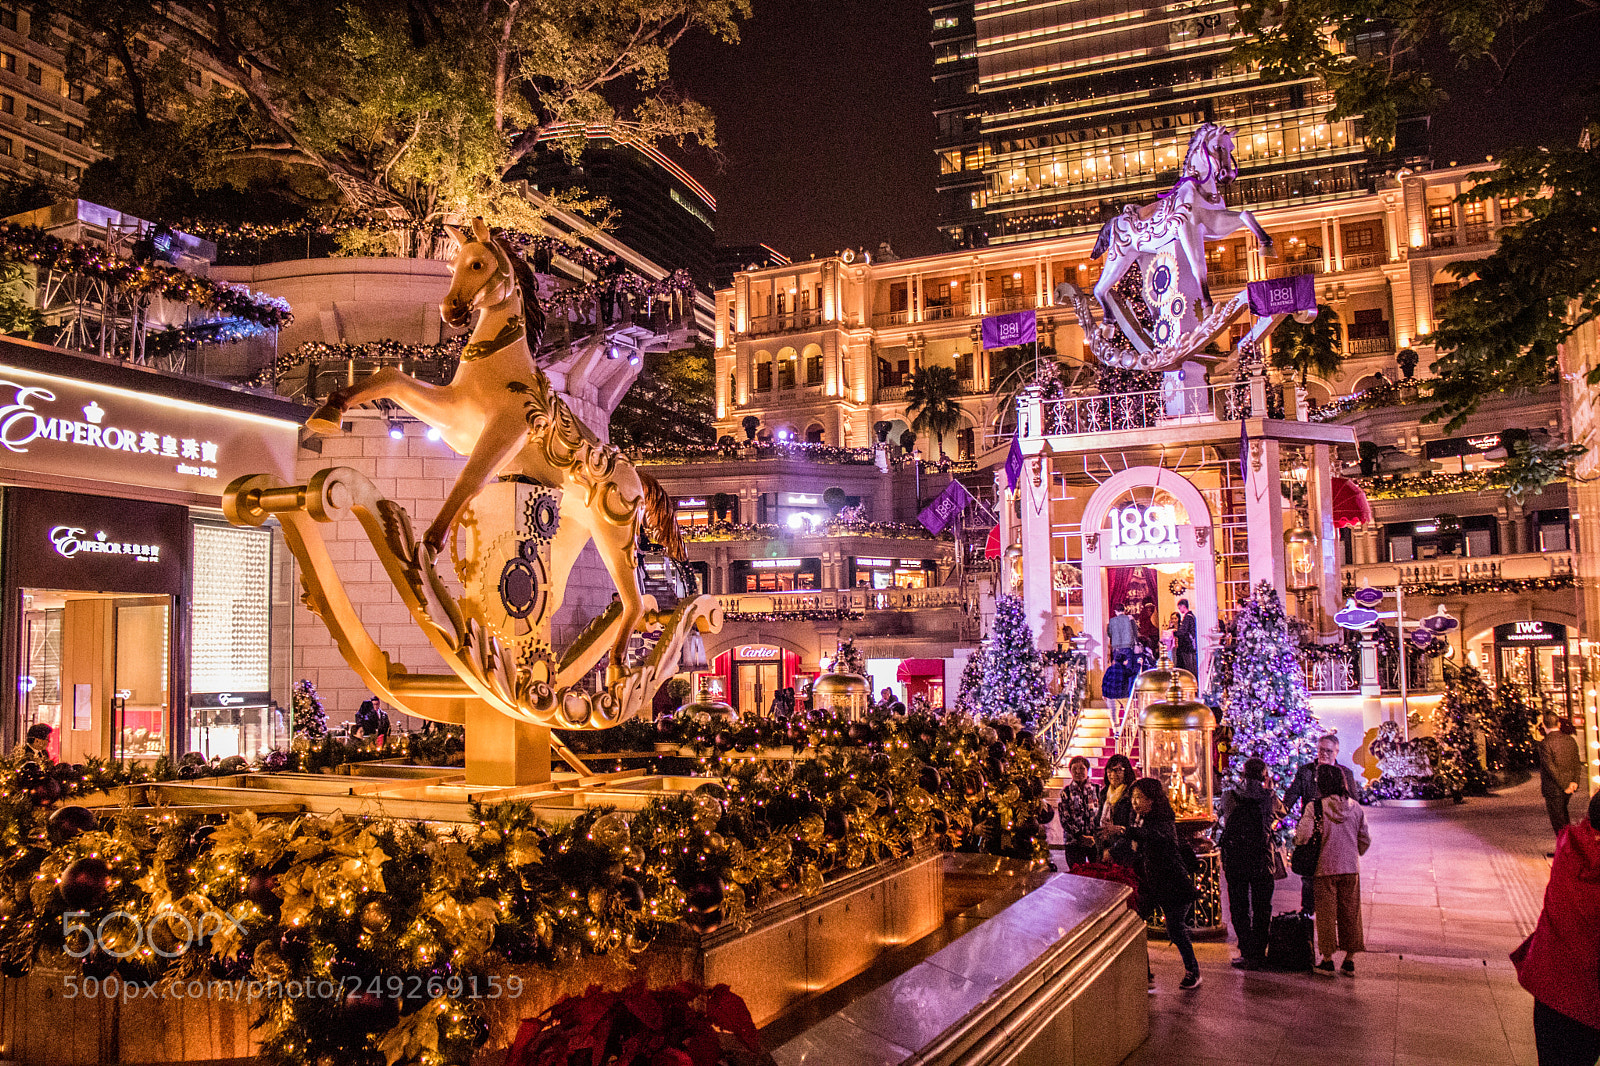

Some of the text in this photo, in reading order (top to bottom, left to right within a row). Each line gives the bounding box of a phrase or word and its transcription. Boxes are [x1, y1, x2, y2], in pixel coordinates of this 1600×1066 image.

[1269, 287, 1293, 302] 1881
[1000, 322, 1019, 336] 1881
[0, 380, 140, 453] EMPEROR
[139, 430, 219, 464] 英皇珠寶
[935, 497, 957, 518] 1881
[1108, 504, 1179, 546] 1881
[48, 526, 122, 559] EMPEROR
[1515, 621, 1543, 634] IWC
[740, 646, 779, 658] Cartier
